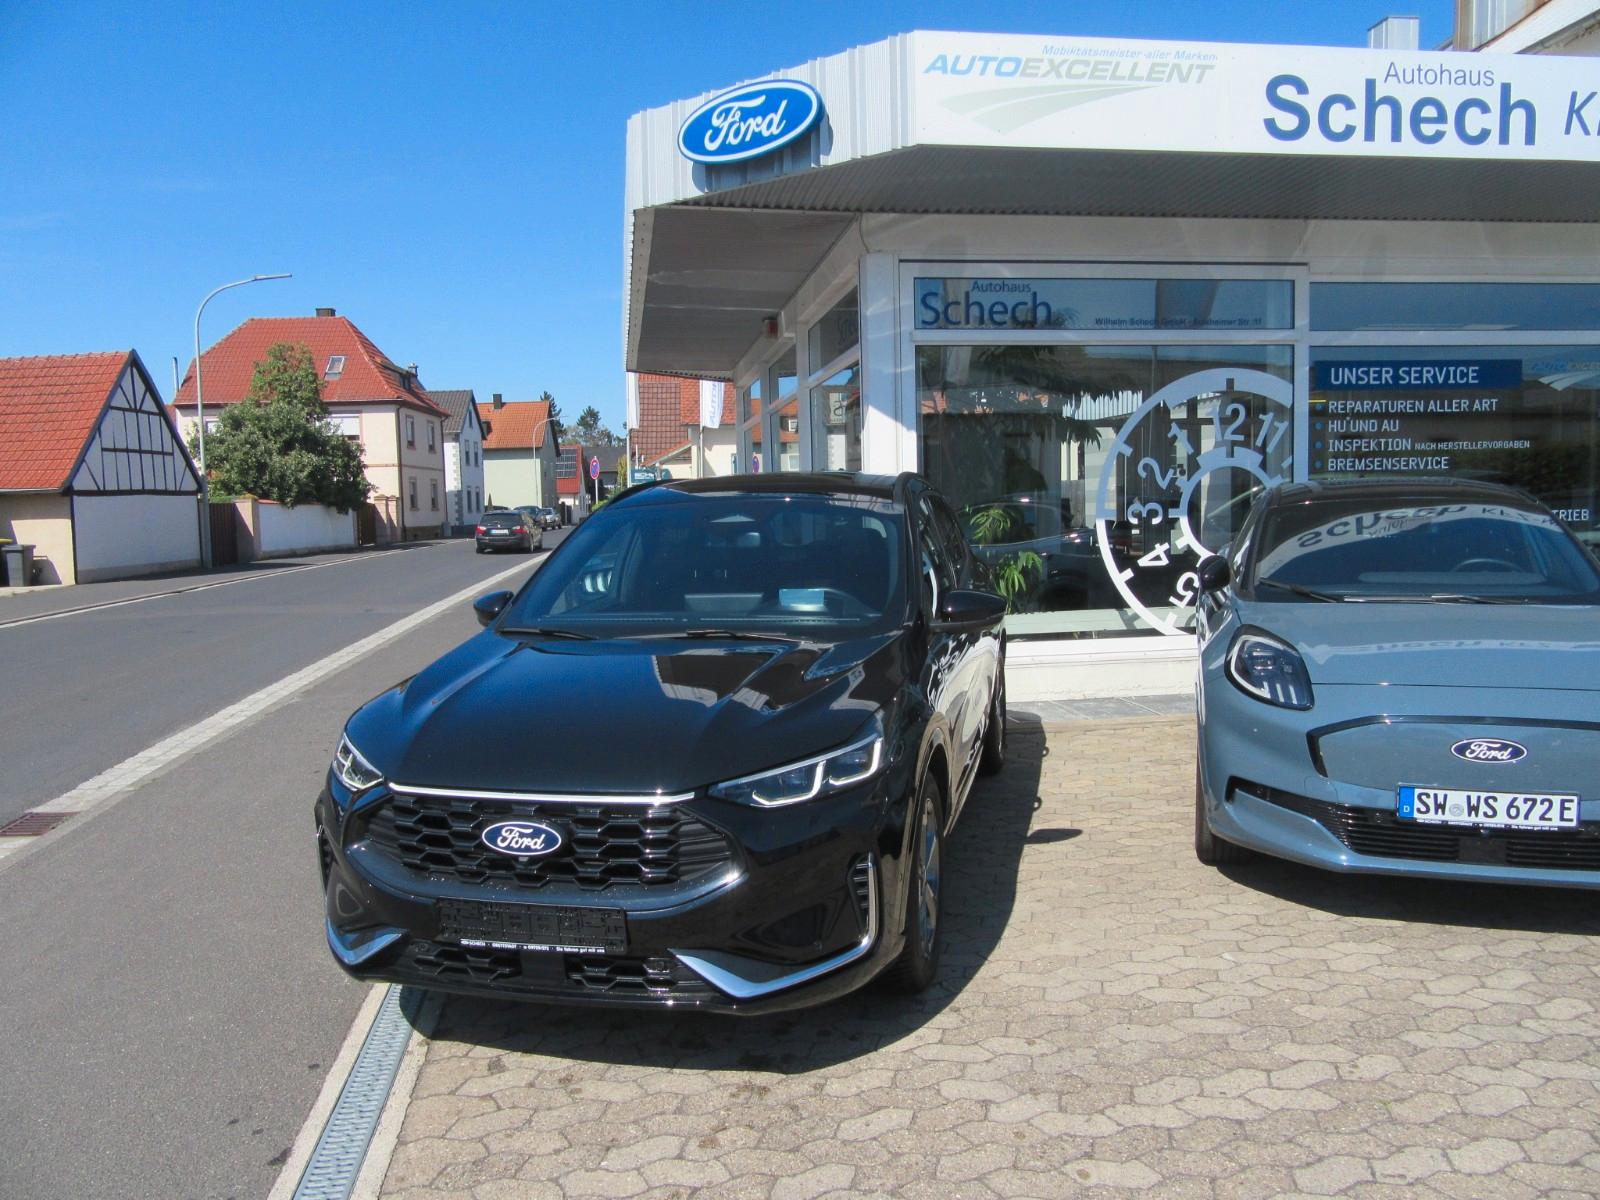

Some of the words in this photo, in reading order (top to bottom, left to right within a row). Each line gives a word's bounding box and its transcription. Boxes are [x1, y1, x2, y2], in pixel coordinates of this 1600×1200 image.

[1384, 61, 1495, 87] Autohaus
[1263, 74, 1537, 146] Schech
[1564, 91, 1600, 136] K
[703, 95, 786, 152] Ford
[972, 280, 1031, 293] Autohaus
[920, 291, 1052, 327] Schech
[1330, 367, 1393, 385] UNSER
[1398, 366, 1479, 384] SERVICE
[1328, 400, 1424, 413] REPARATUREN
[1427, 400, 1469, 412] ALLER
[1473, 399, 1498, 411] ART
[1210, 403, 1246, 441] 12
[1328, 420, 1346, 432] HU
[1350, 420, 1378, 432] UND
[1381, 419, 1399, 432] AU
[1328, 438, 1412, 452] INSPEKTION
[1414, 442, 1436, 450] NACH
[1438, 440, 1530, 450] HERSTELLERVORGABEN
[1137, 457, 1174, 490] 2
[1328, 456, 1449, 471] BREMSENSERVICE
[1127, 502, 1163, 525] 3
[1137, 542, 1170, 567] 4
[1169, 571, 1200, 609] 5
[1466, 741, 1512, 760] Ford
[1403, 805, 1410, 813] D
[1416, 792, 1448, 816] SW
[1466, 794, 1498, 819] WS
[1506, 796, 1575, 822] 672E
[497, 827, 545, 850] Ford
